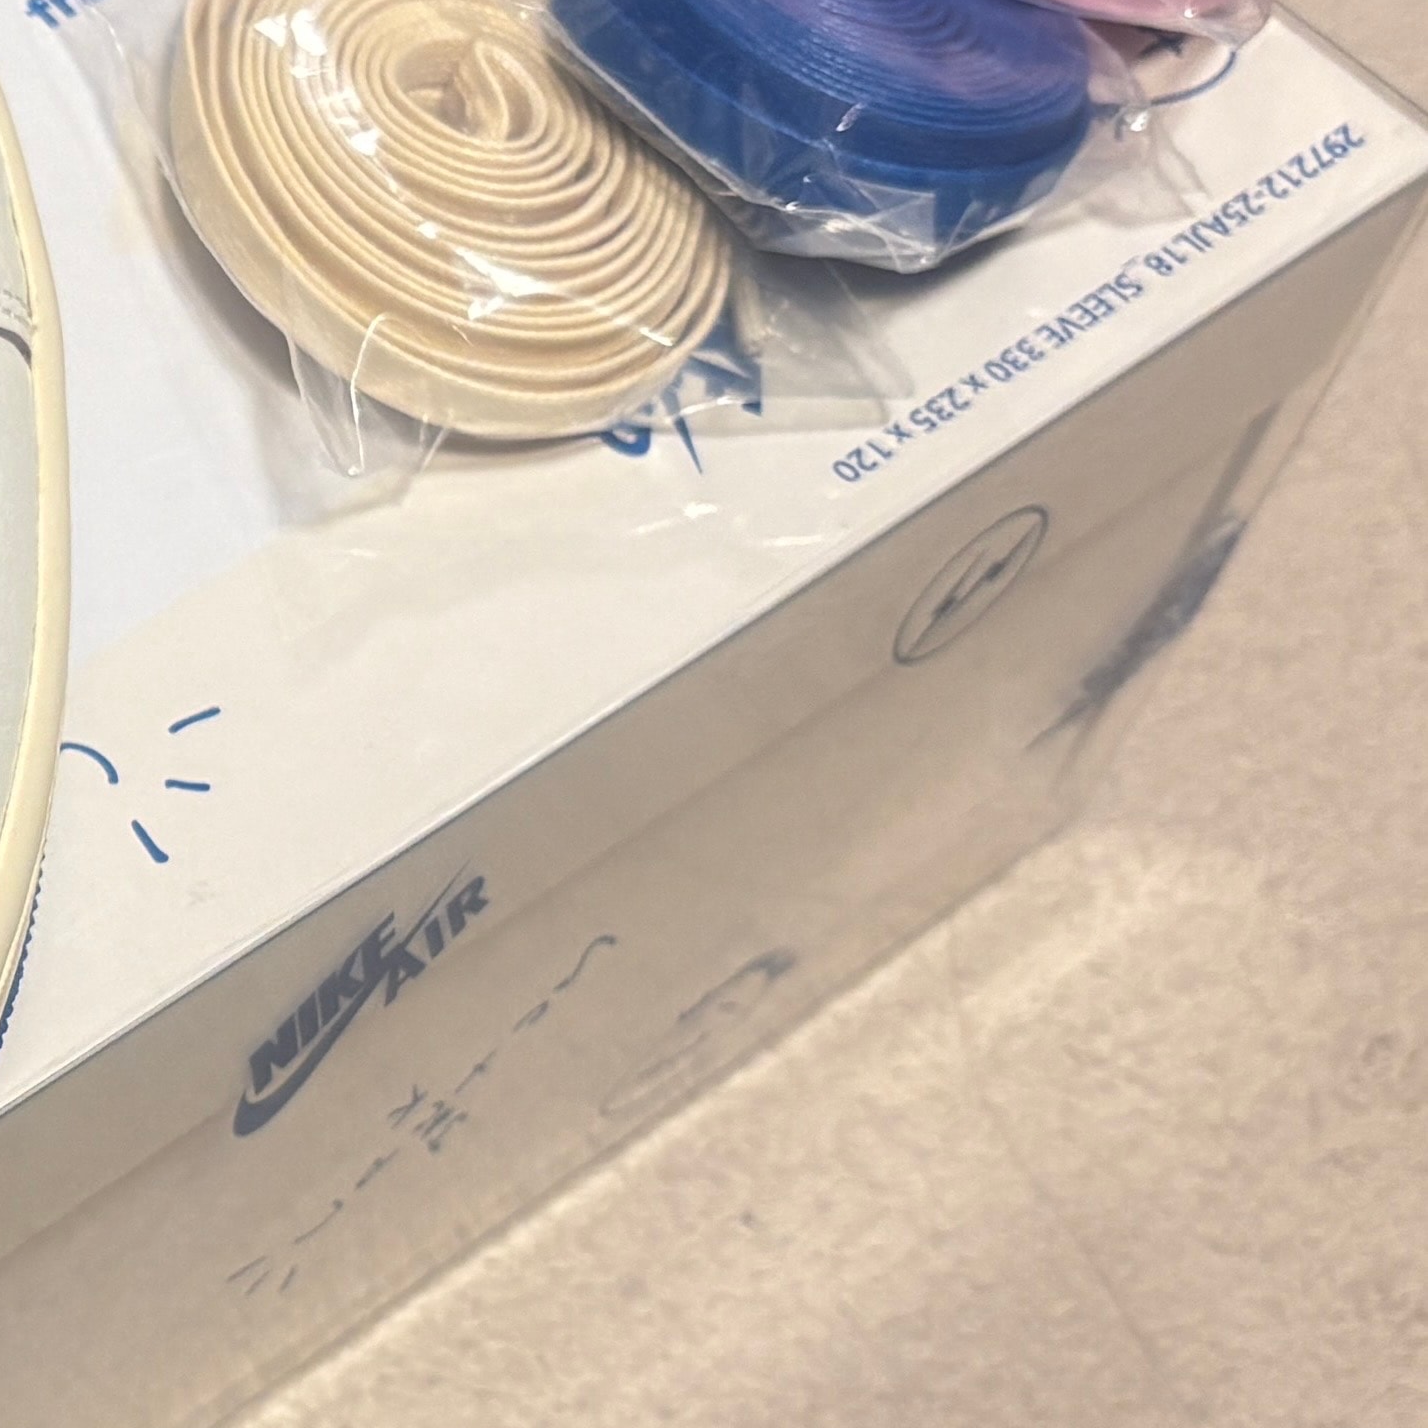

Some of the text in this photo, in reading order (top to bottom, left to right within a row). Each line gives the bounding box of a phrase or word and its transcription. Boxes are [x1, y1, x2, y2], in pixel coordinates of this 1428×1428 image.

[983, 336, 1046, 384] 330
[907, 387, 974, 435] 235
[832, 436, 895, 483] 120
[383, 874, 491, 1008] AIR
[249, 909, 397, 1097] NIKE
